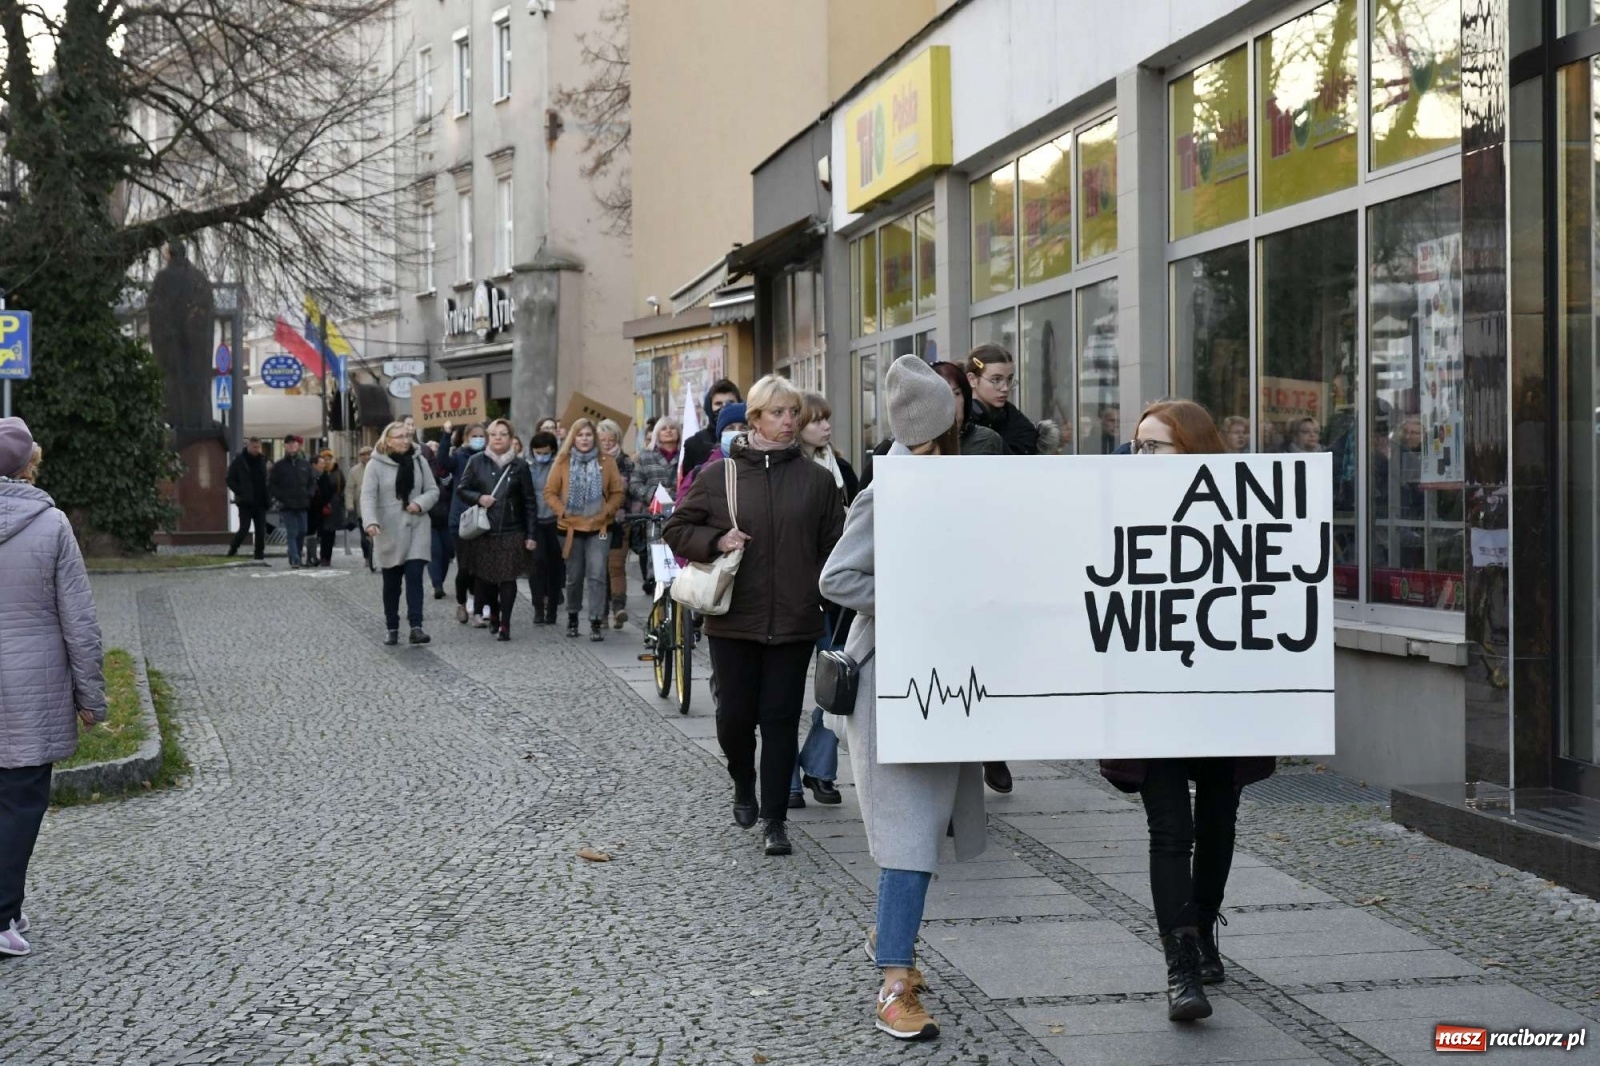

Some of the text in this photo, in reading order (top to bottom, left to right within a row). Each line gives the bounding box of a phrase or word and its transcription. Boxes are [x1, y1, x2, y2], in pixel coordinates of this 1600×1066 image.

[420, 388, 477, 413] STOP
[1172, 460, 1307, 523] ANI
[1085, 521, 1331, 588] JEDNEJ
[1084, 585, 1319, 668] WIĘCEJ
